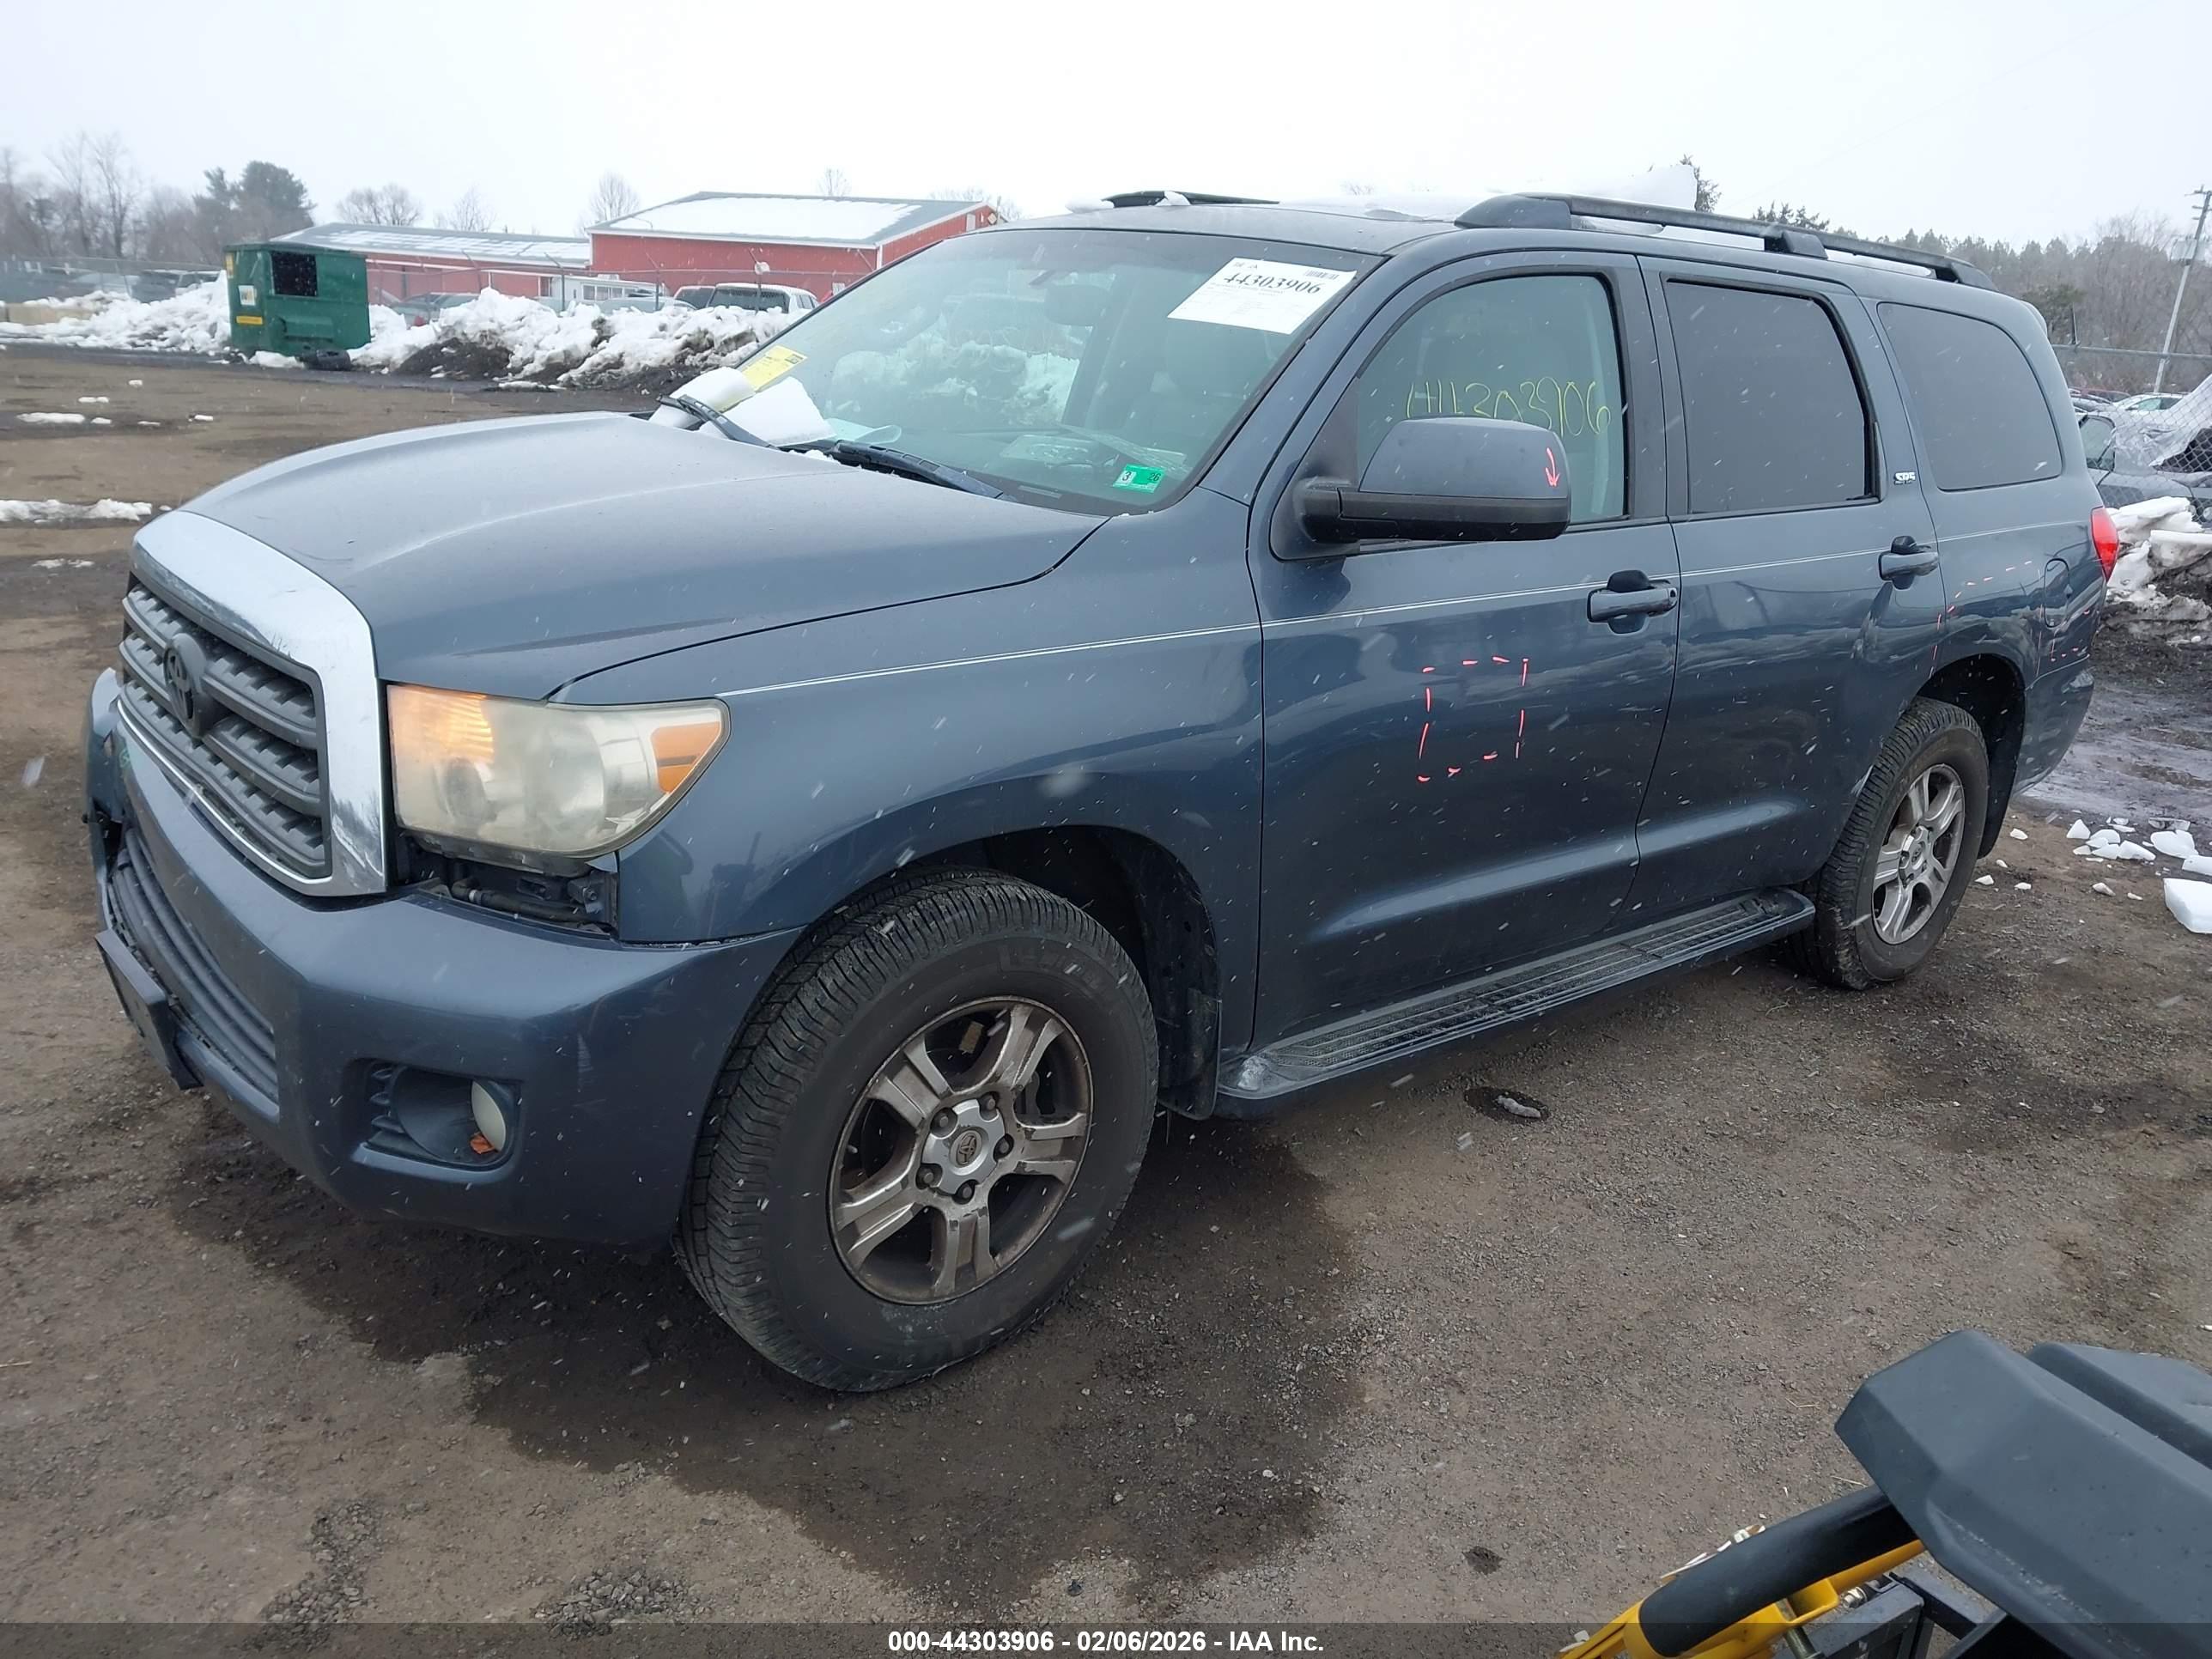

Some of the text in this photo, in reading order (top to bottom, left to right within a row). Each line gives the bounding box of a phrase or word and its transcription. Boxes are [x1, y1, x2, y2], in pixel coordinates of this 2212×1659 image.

[1224, 272, 1326, 295] 44303906
[1121, 471, 1162, 482] 3 26
